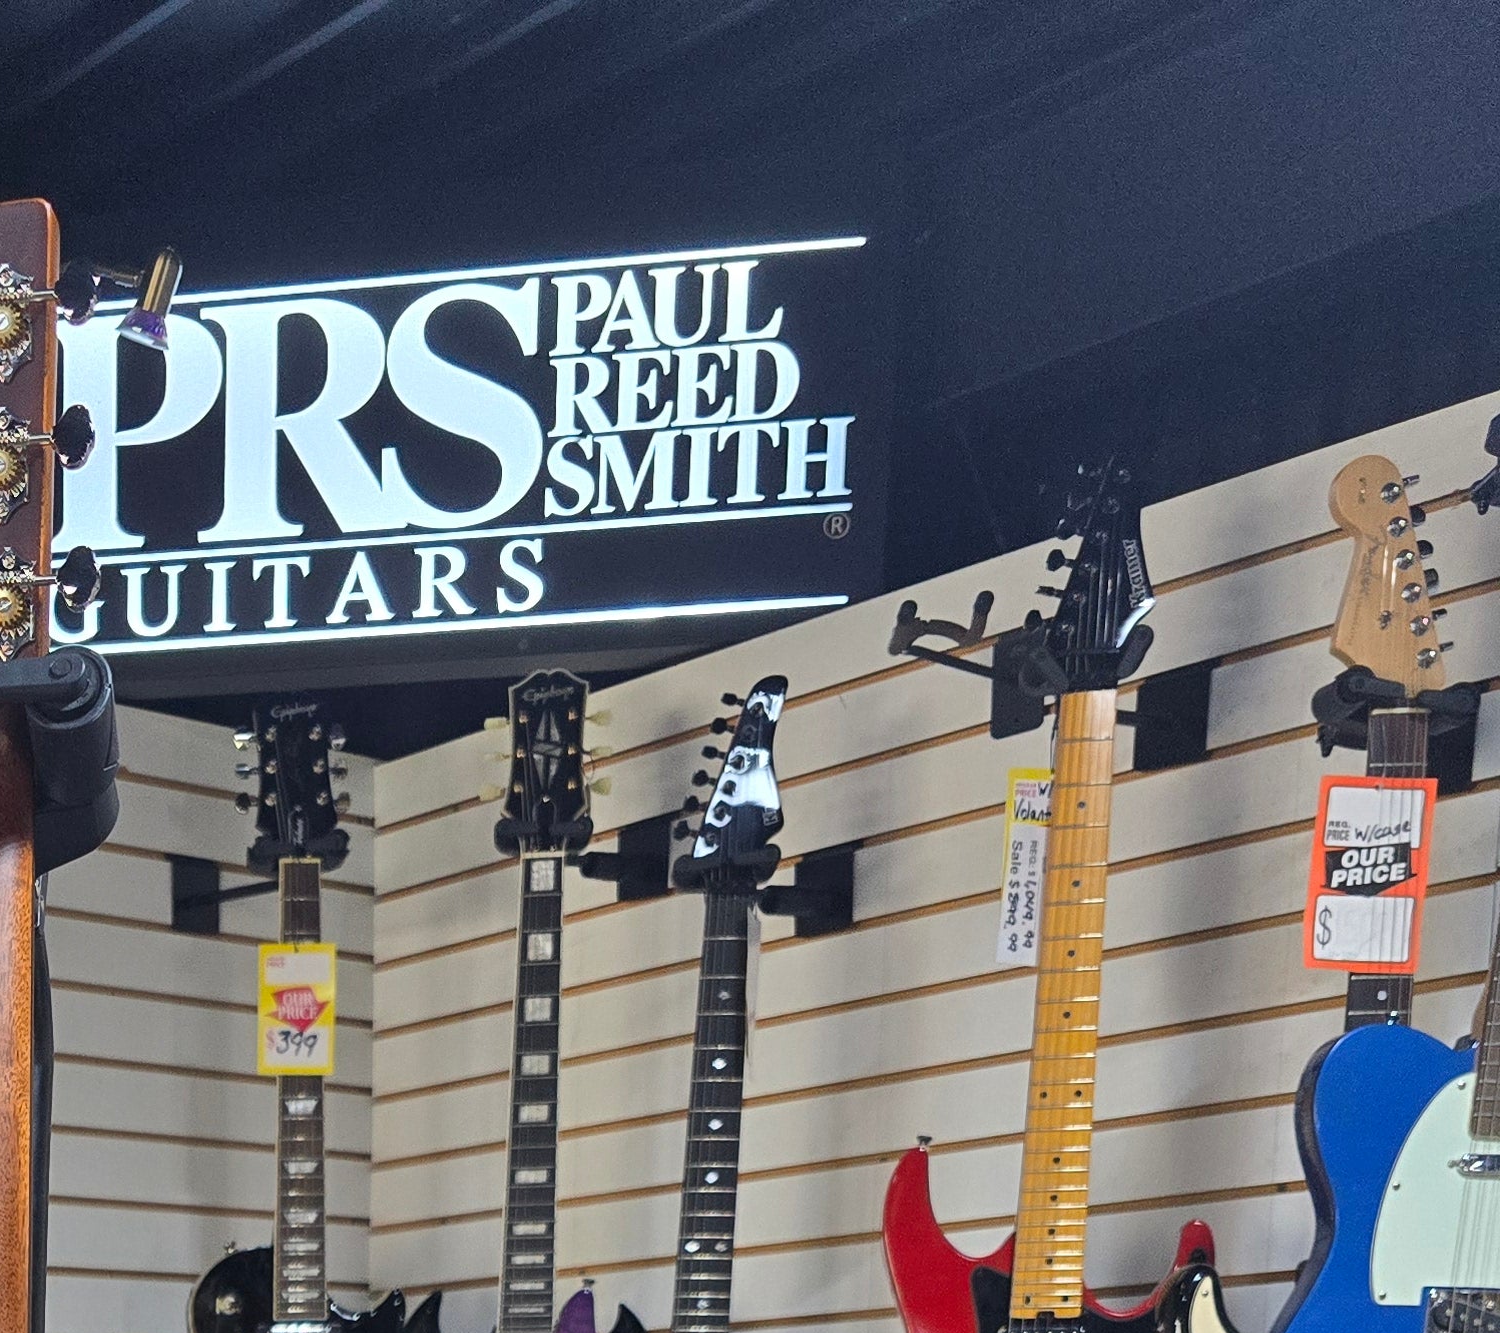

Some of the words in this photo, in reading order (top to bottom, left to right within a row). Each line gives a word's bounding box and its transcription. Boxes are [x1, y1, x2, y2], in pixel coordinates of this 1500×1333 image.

[550, 261, 782, 357] PAUL
[548, 340, 800, 437] REED
[55, 279, 543, 549] PRS
[544, 416, 856, 519] SMITH
[49, 538, 546, 644] GUITARS
[1327, 830, 1350, 841] PRICE
[1010, 841, 1023, 874] Sale
[1331, 863, 1407, 888] PRICE
[1341, 847, 1395, 868] OUR
[1316, 905, 1332, 949] $
[278, 1005, 318, 1020] PRICE
[283, 992, 312, 1004] OUR
